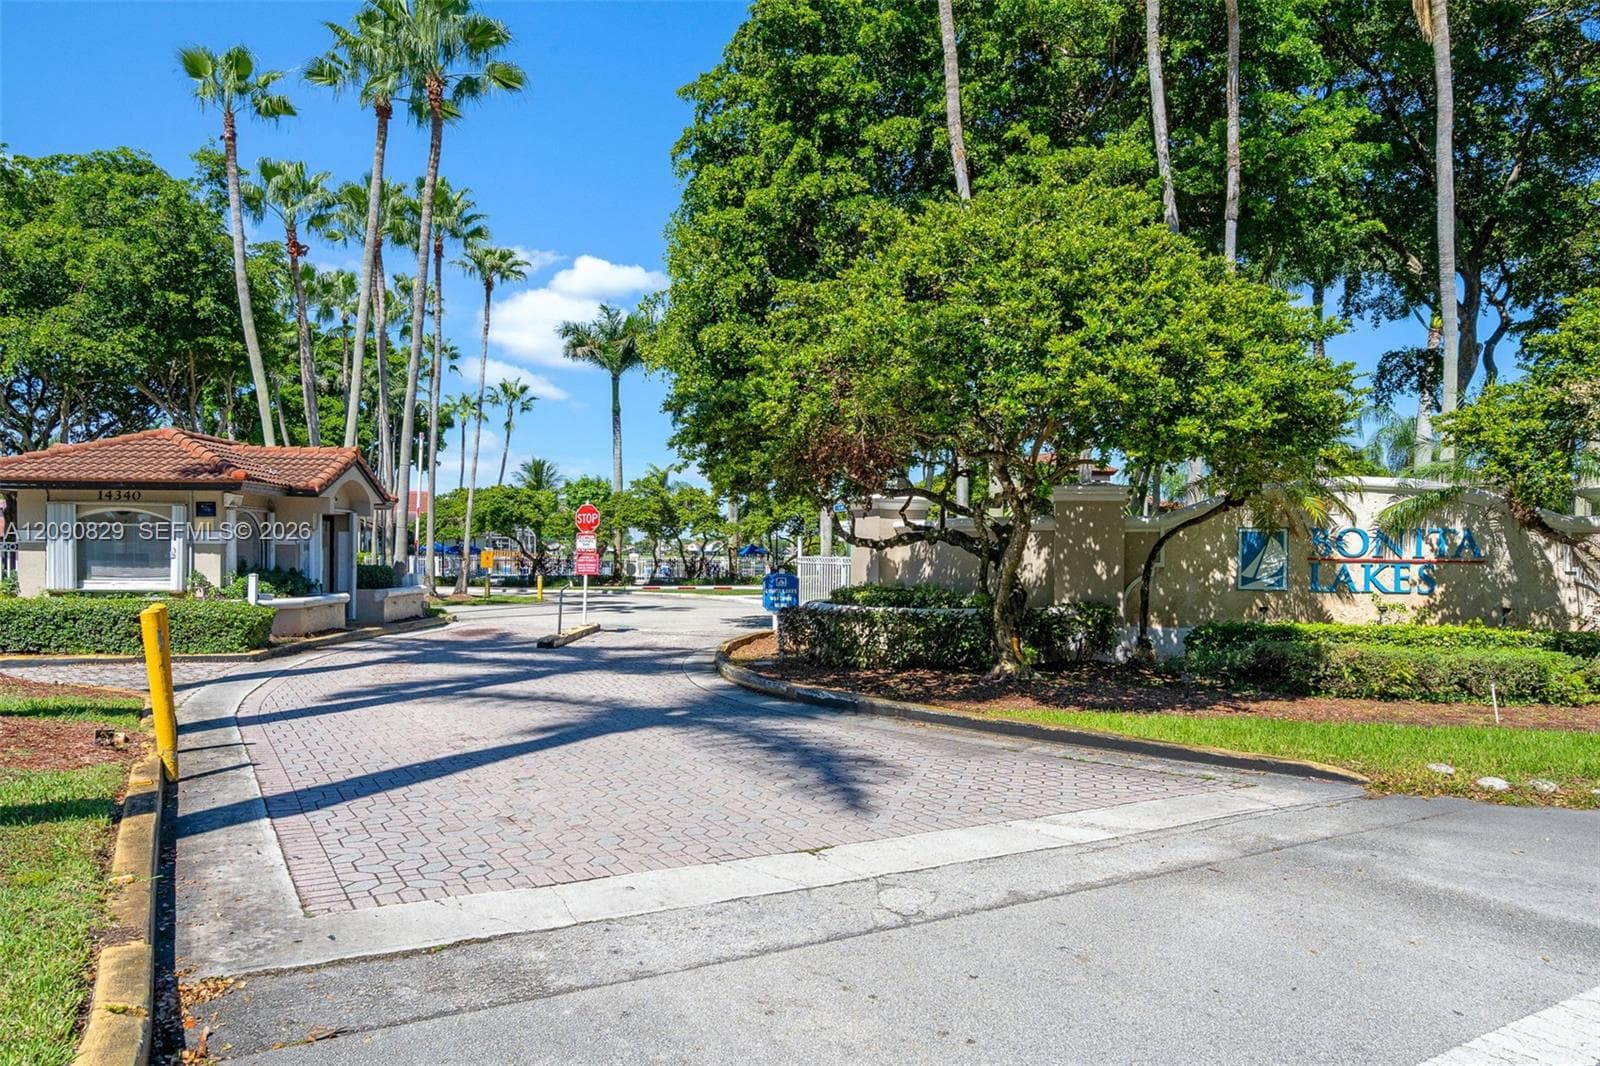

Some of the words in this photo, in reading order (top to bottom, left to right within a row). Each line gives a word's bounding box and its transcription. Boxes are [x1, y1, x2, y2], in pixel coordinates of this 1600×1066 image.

[98, 490, 142, 501] 14340
[577, 513, 598, 524] STOP
[1311, 527, 1485, 558] BONITA
[1308, 563, 1437, 595] LAKES
